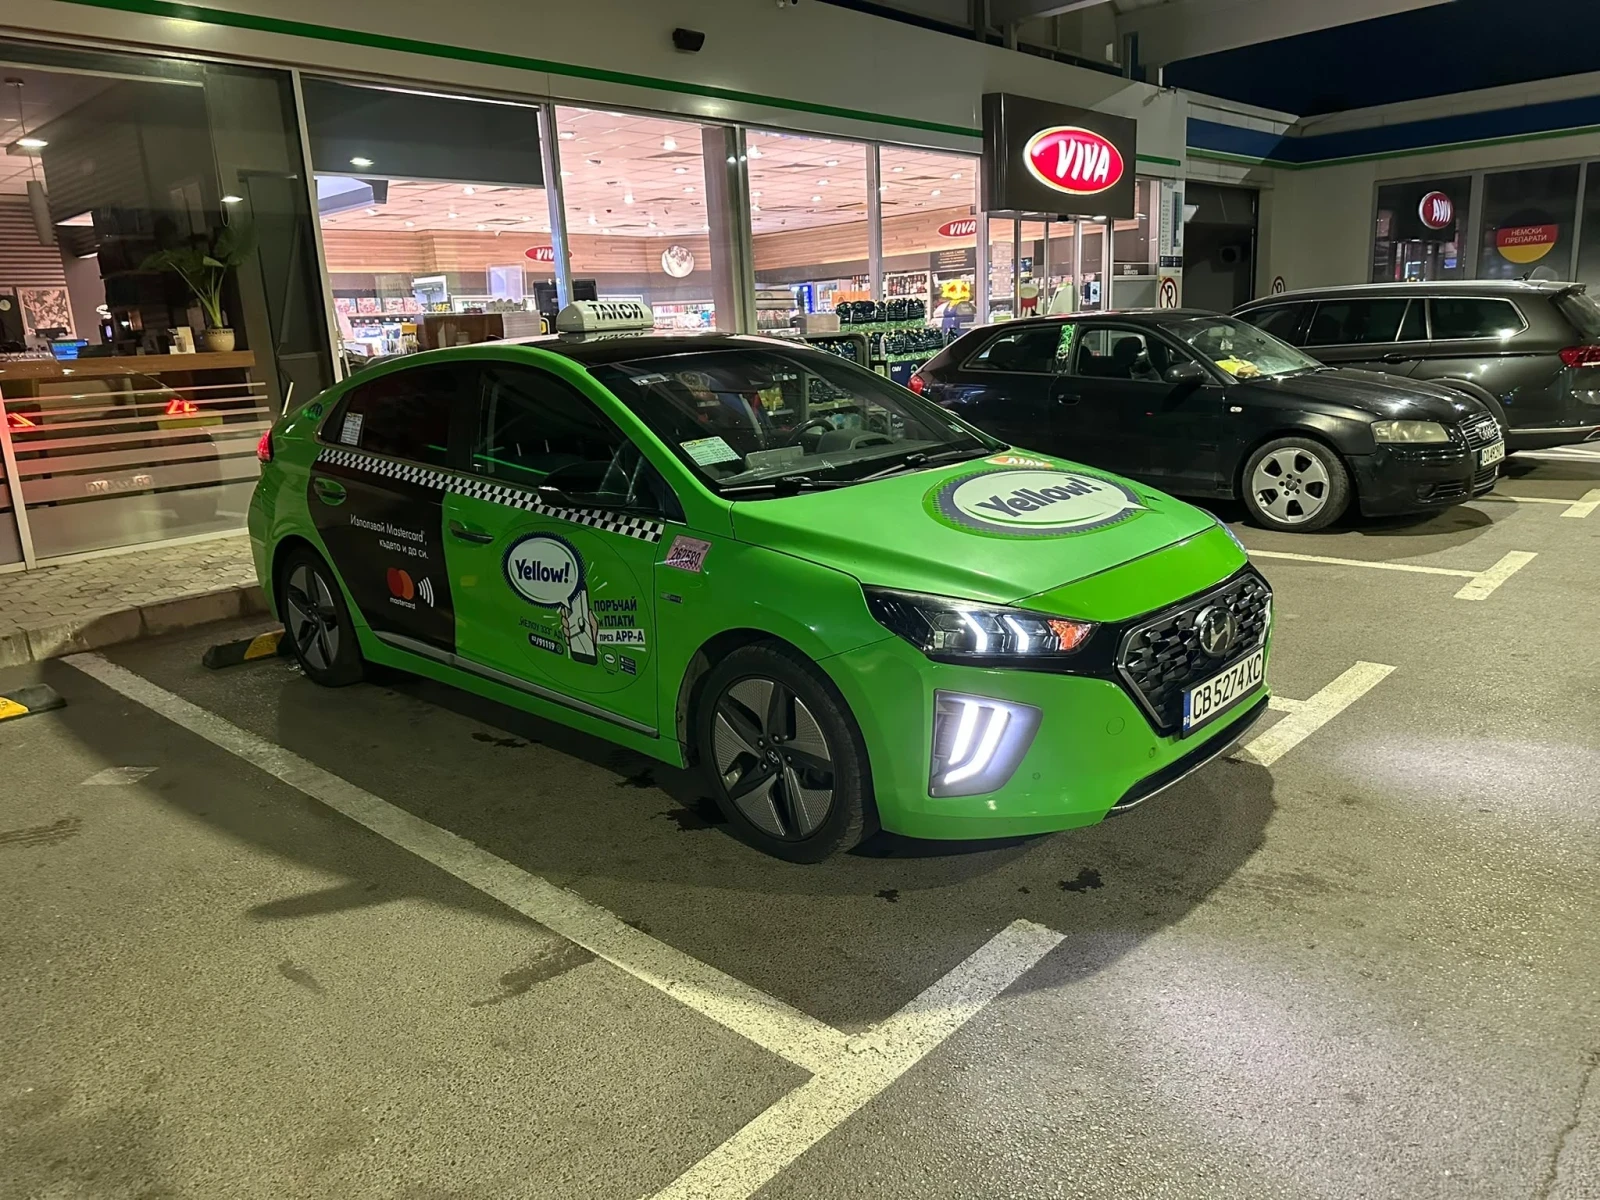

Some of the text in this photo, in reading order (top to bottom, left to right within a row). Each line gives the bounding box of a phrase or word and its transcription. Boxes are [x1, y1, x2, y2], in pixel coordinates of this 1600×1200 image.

[1056, 138, 1110, 183] VIVA
[950, 220, 976, 235] VIVA
[1511, 227, 1543, 236] НЕМСКИ
[1505, 234, 1548, 244] ПРЕПАРАТИ
[536, 248, 555, 260] VIV
[587, 303, 644, 320] ТАКСИ
[975, 477, 1102, 518] Yellow!
[350, 513, 386, 533] Използвай
[379, 539, 401, 552] където
[408, 547, 417, 557] да
[515, 558, 571, 584] Yellow!
[389, 597, 416, 610] mastercard
[594, 596, 637, 612] ПОРЪЧАЙ
[604, 615, 635, 627] ПЛАТИ
[599, 634, 614, 642] ПРЕЗ
